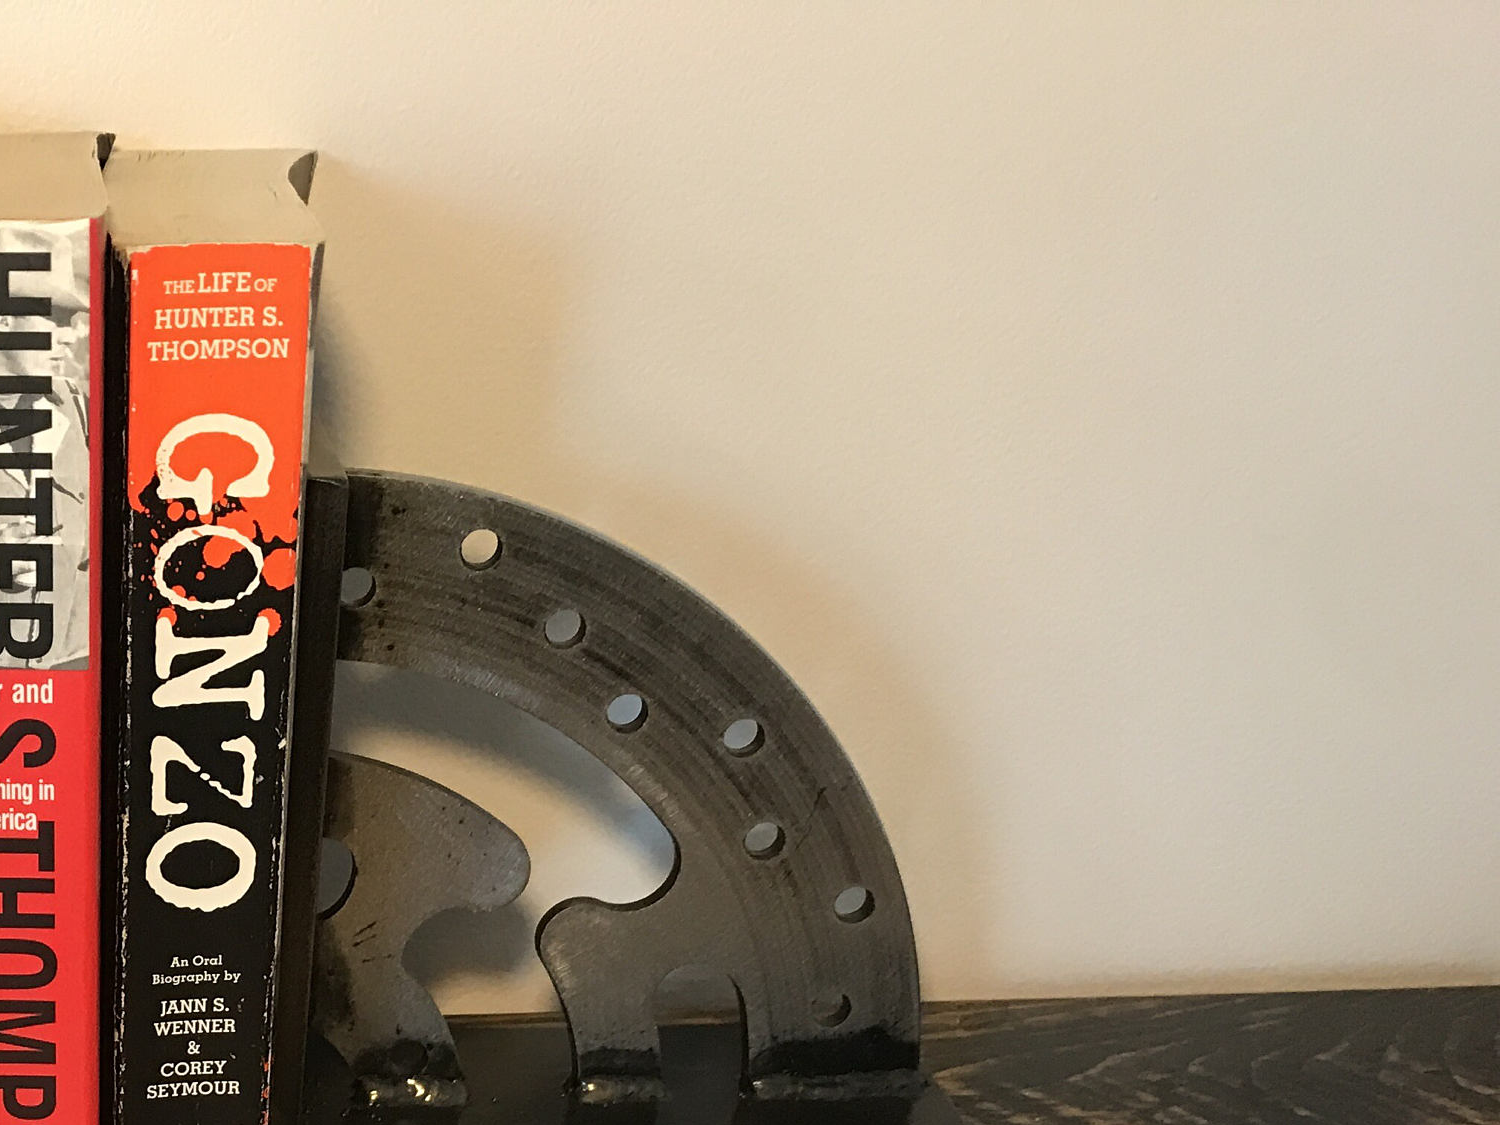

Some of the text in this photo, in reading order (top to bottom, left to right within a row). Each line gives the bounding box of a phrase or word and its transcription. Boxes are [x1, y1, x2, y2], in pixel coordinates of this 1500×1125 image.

[163, 272, 278, 294] THE LIFE OF
[154, 306, 283, 330] HUNTER S.
[147, 338, 290, 362] THOMPSON
[145, 413, 275, 912] GONZO
[11, 678, 53, 704] and
[38, 779, 55, 801] in
[170, 954, 223, 968] An Oral
[152, 970, 241, 986] Biography by
[160, 998, 230, 1017] JANN S.
[153, 1018, 236, 1037] WENNER
[187, 1040, 200, 1055] &
[160, 1060, 227, 1077] COREY
[146, 1080, 240, 1100] SEYMOUR
